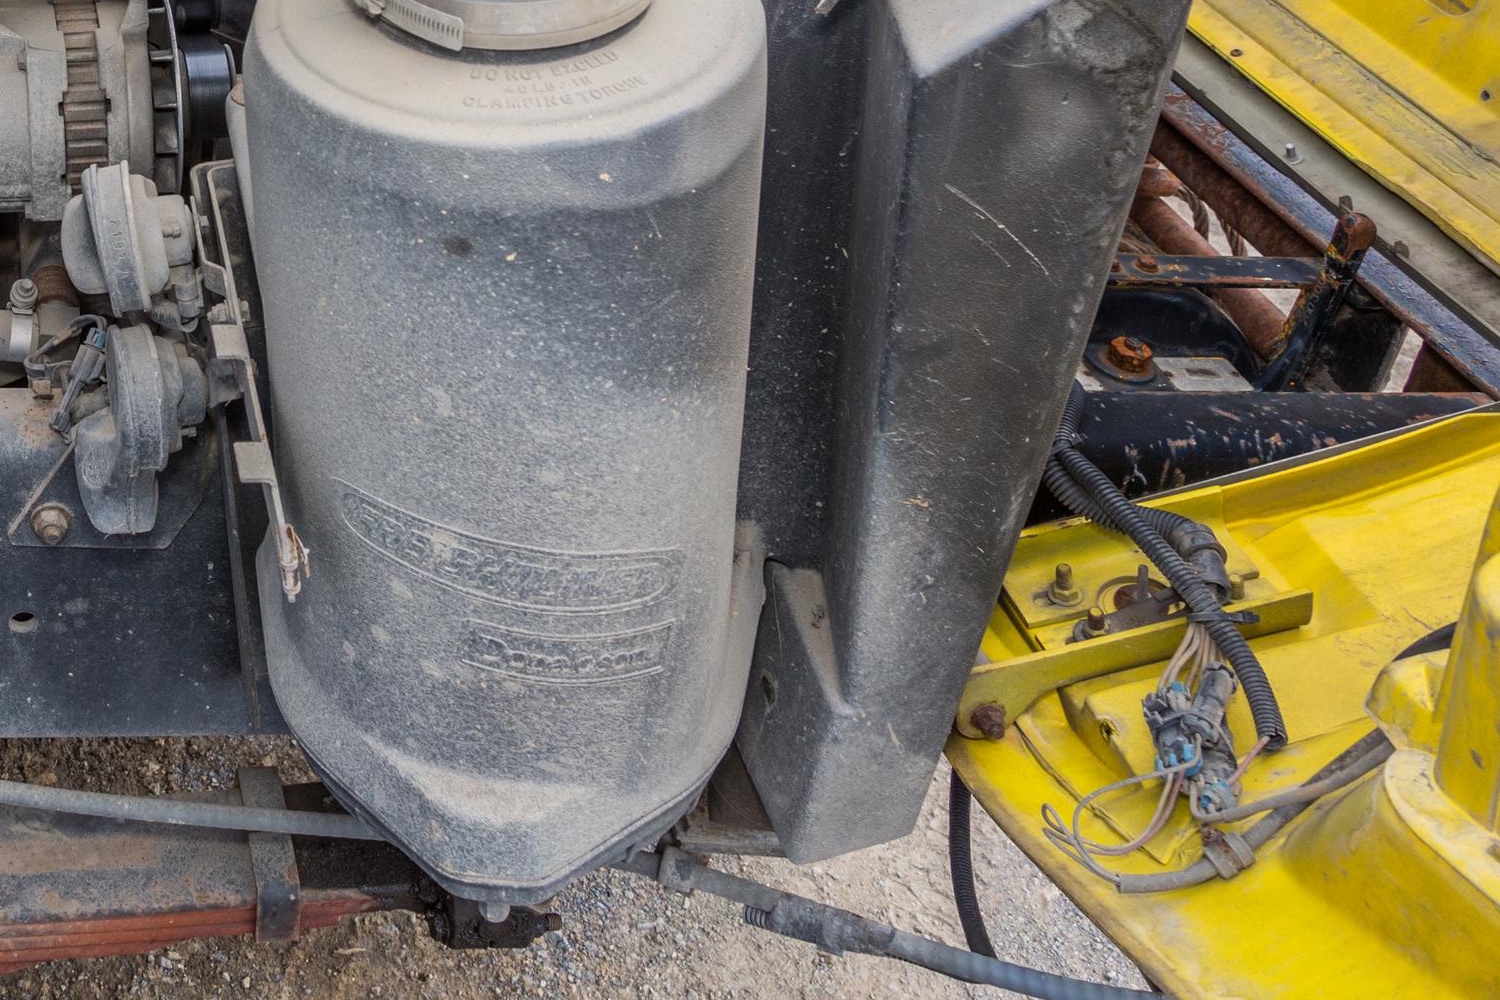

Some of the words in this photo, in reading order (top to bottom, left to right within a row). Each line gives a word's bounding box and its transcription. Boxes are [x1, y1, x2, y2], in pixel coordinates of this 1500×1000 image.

[469, 66, 499, 82] DO
[505, 67, 542, 82] NOT
[550, 49, 620, 78] EXCEED
[462, 93, 574, 109] CLAMPING
[576, 75, 650, 104] TORQUE
